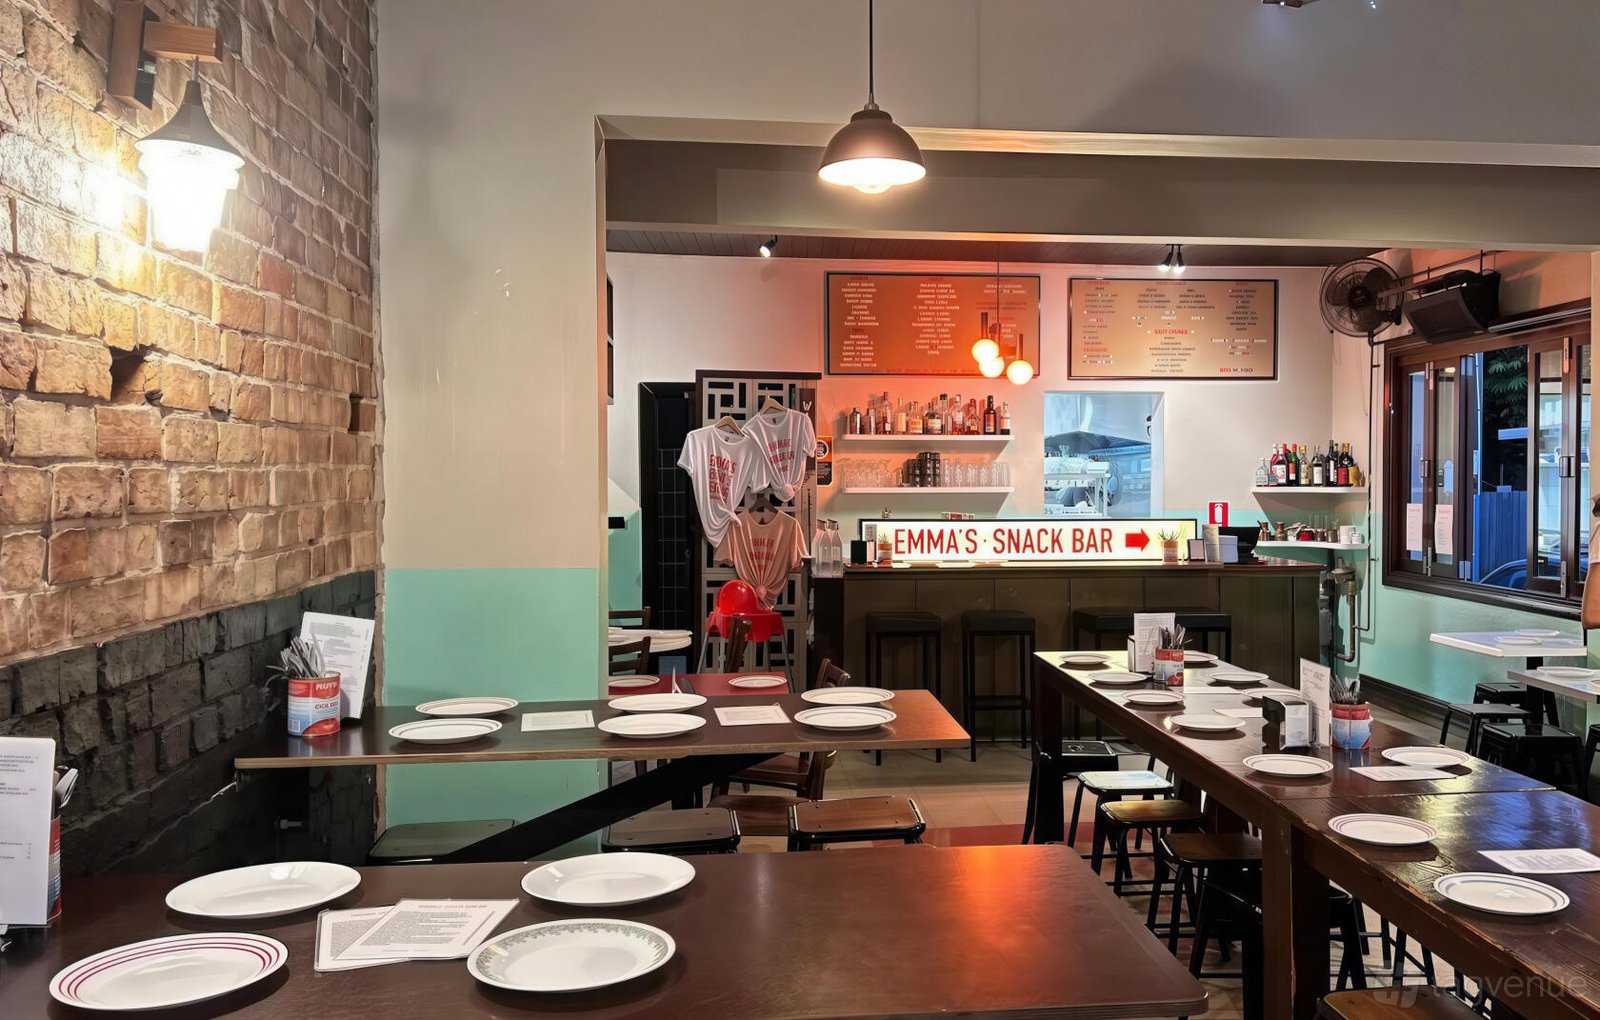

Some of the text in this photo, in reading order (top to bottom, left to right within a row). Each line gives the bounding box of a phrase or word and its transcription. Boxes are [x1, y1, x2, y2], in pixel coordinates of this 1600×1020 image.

[894, 527, 1113, 555] EMMA'S SNACK BAR
